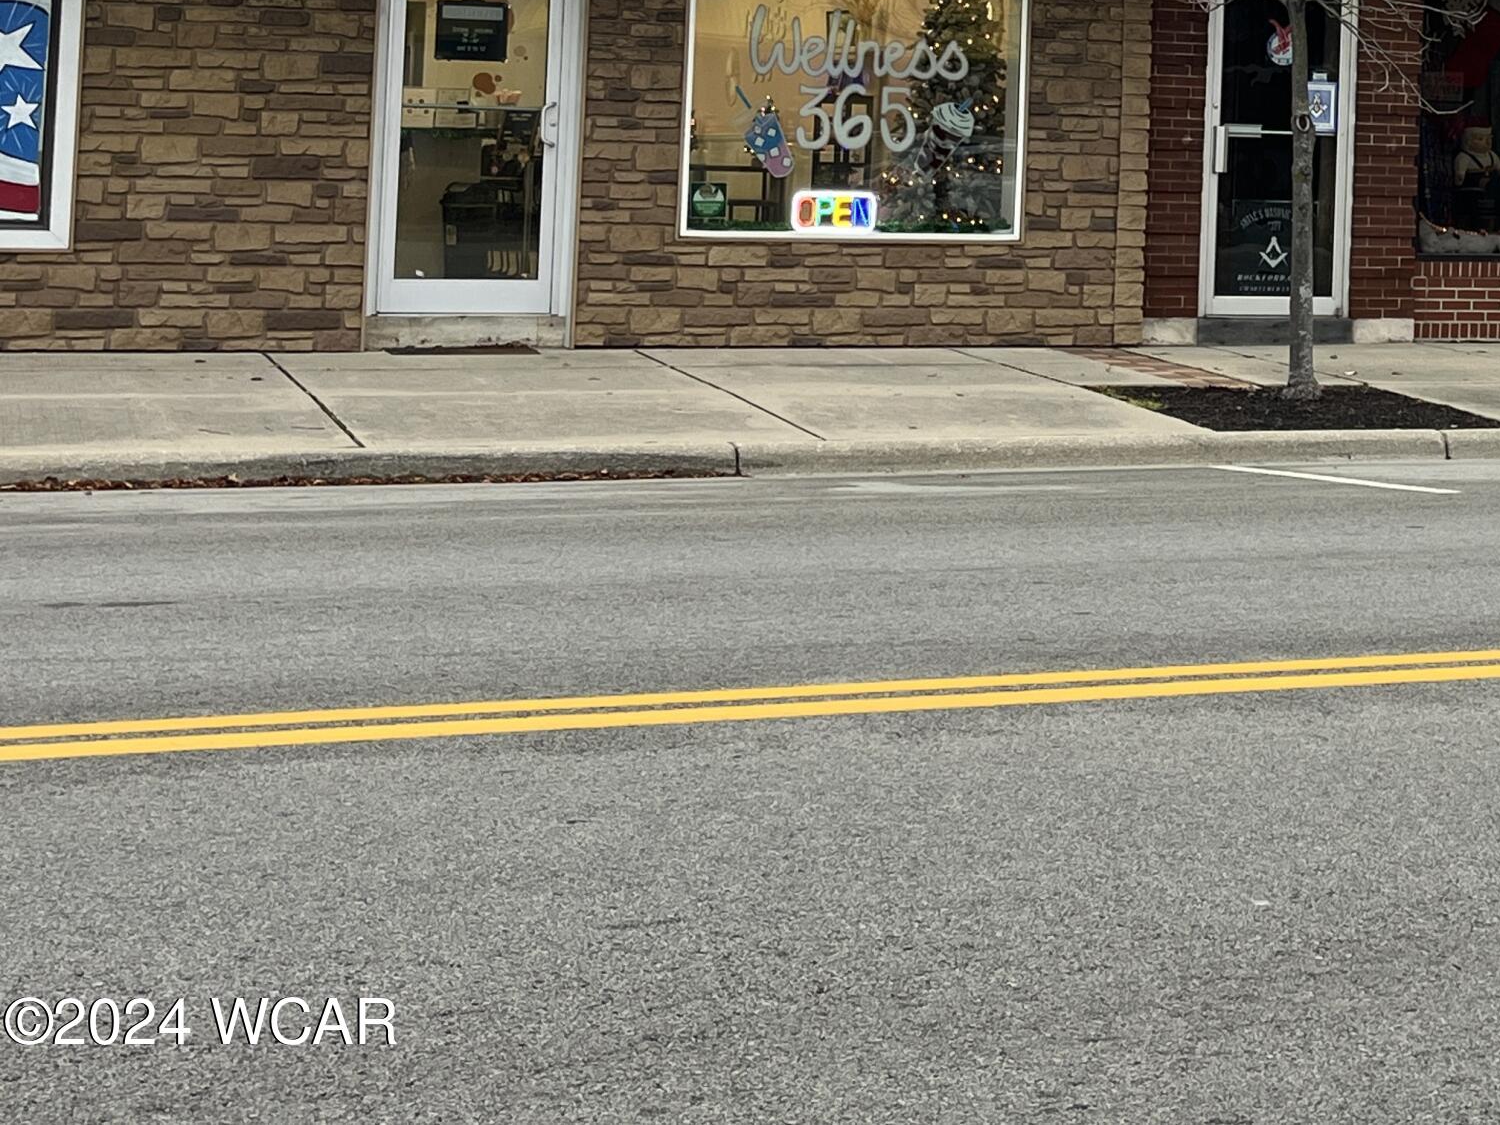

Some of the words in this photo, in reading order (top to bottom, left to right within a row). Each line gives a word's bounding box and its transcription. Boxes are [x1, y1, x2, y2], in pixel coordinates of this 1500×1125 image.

[749, 3, 969, 81] Wellness
[796, 83, 916, 152] 365
[796, 196, 872, 227] OPEN
